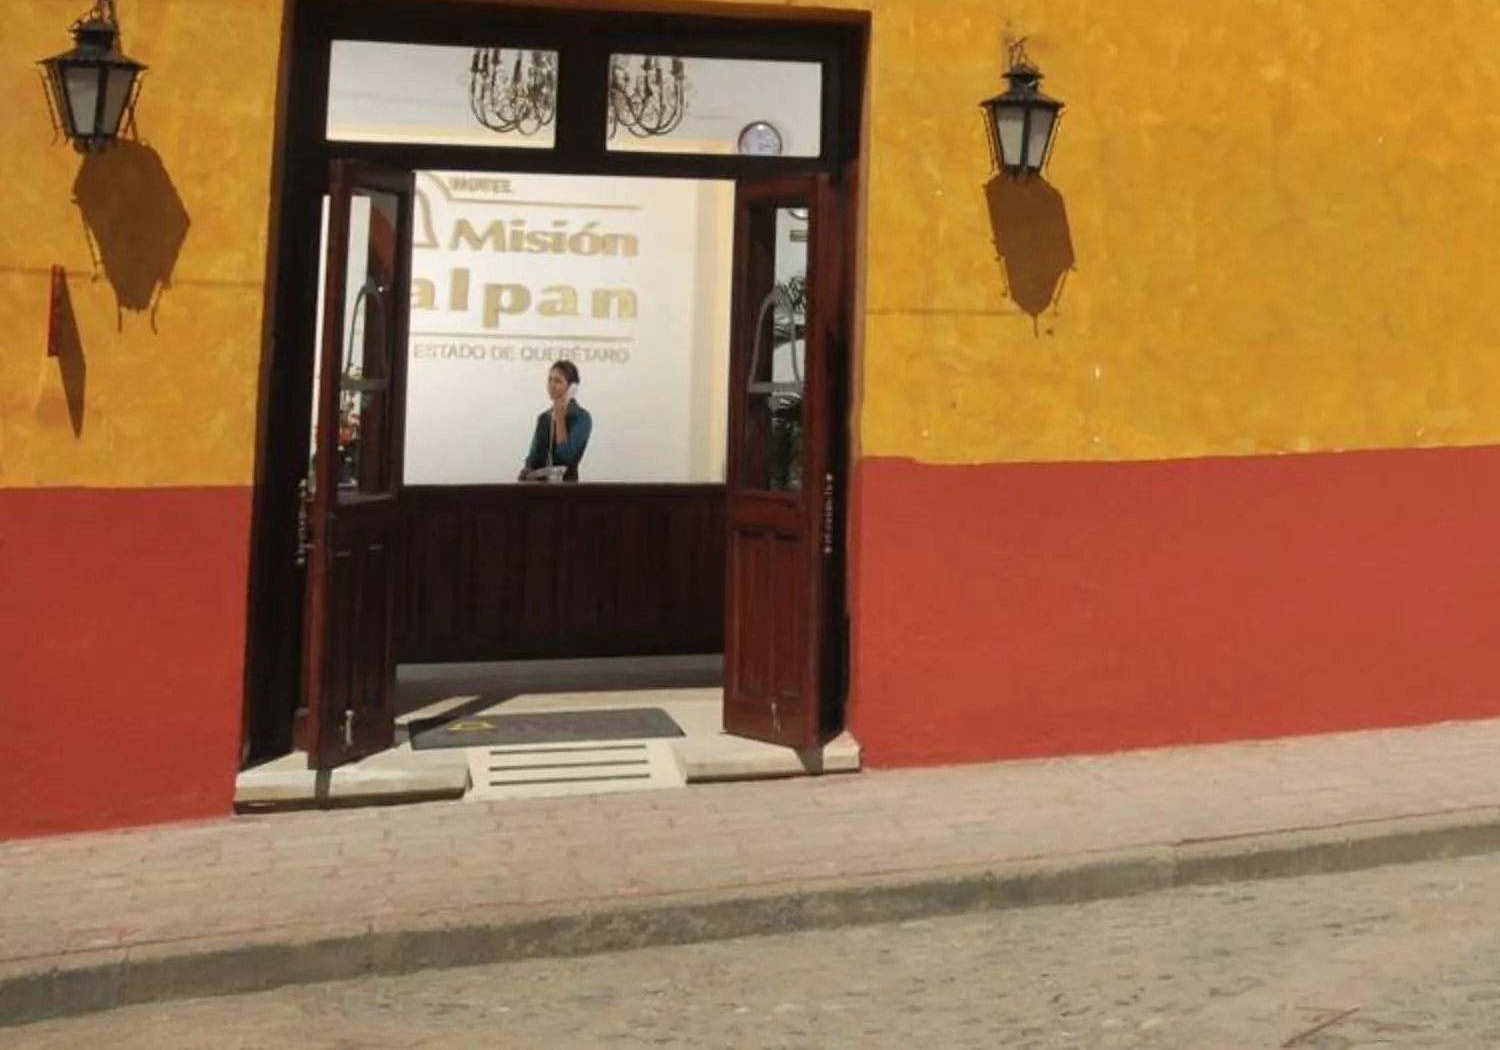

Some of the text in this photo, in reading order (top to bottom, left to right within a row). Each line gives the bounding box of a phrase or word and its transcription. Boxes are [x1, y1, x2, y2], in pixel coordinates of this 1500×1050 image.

[449, 217, 639, 257] Misión
[410, 267, 639, 329] alpan
[412, 343, 487, 360] ESTADO
[490, 345, 517, 361] DE
